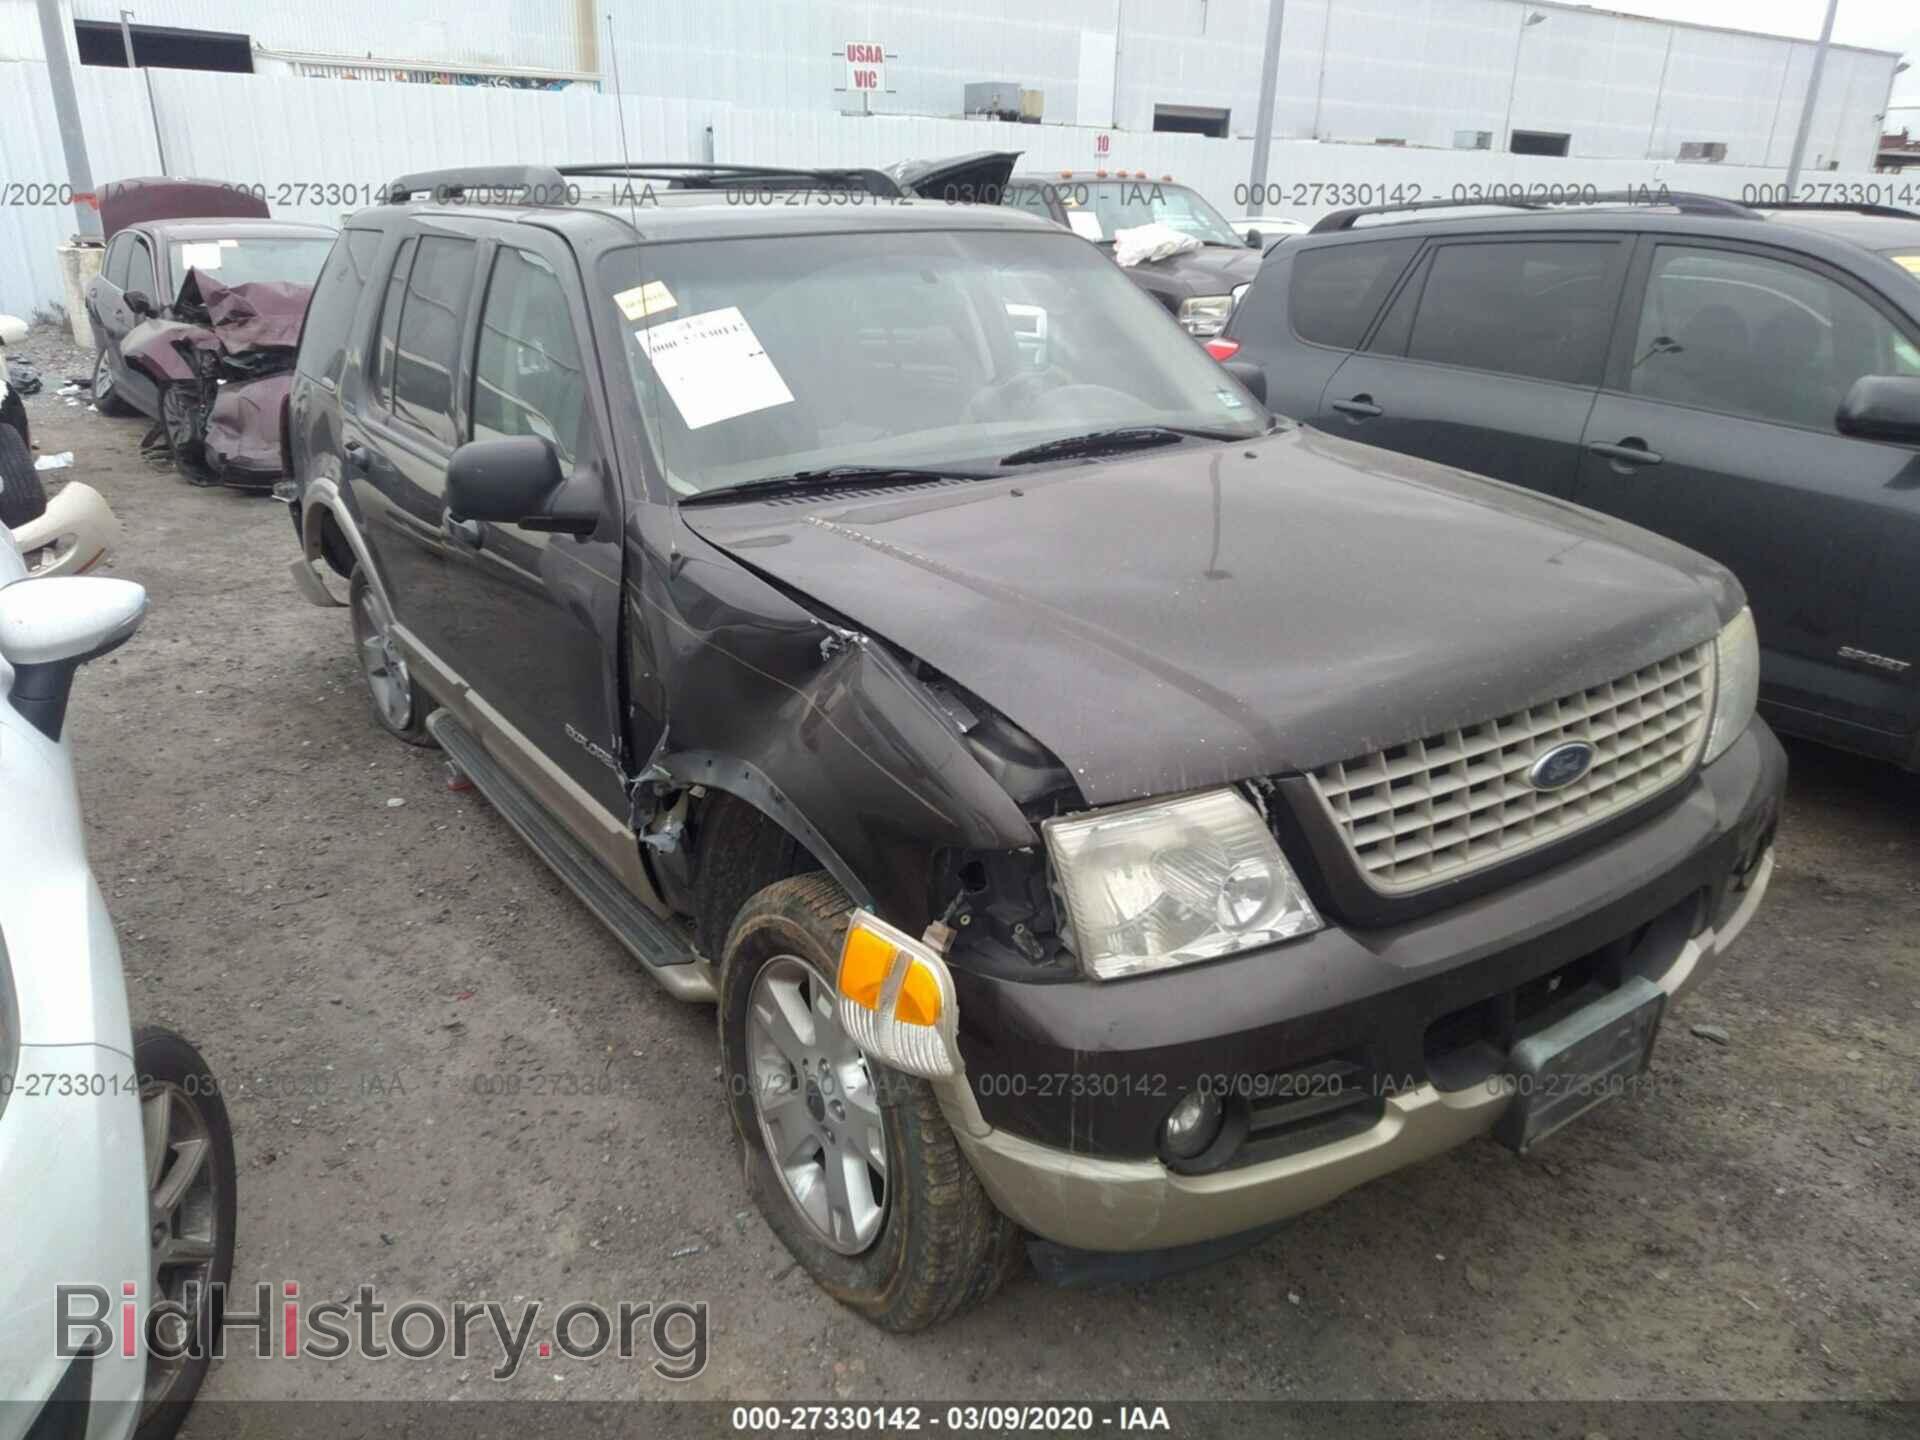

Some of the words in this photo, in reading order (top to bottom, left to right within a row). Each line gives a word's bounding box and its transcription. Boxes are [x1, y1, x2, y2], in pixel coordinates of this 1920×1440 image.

[847, 44, 883, 64] USAA
[854, 70, 877, 89] VIC
[1097, 134, 1110, 152] 10
